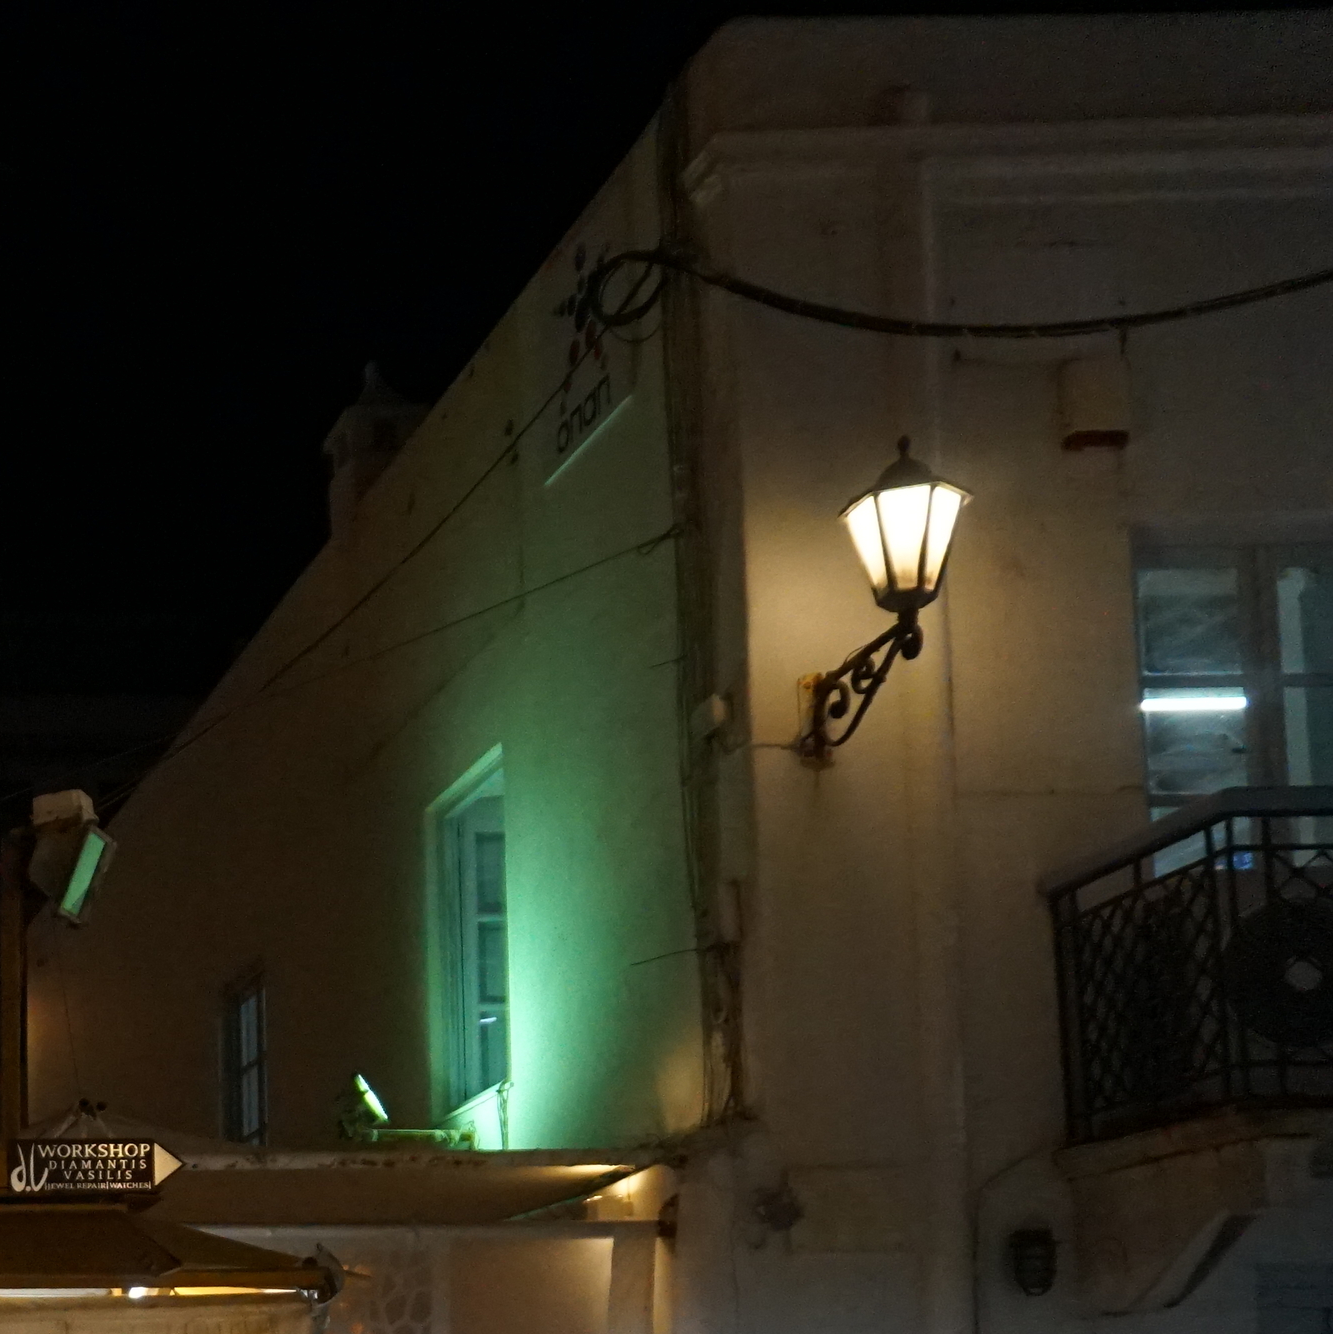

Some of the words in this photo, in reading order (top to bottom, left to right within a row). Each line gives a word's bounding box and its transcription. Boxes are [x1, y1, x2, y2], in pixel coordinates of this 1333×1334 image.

[38, 1143, 151, 1158] WORKSHOP
[49, 1159, 147, 1169] DIAMANTIS
[64, 1170, 133, 1180] VASILIS
